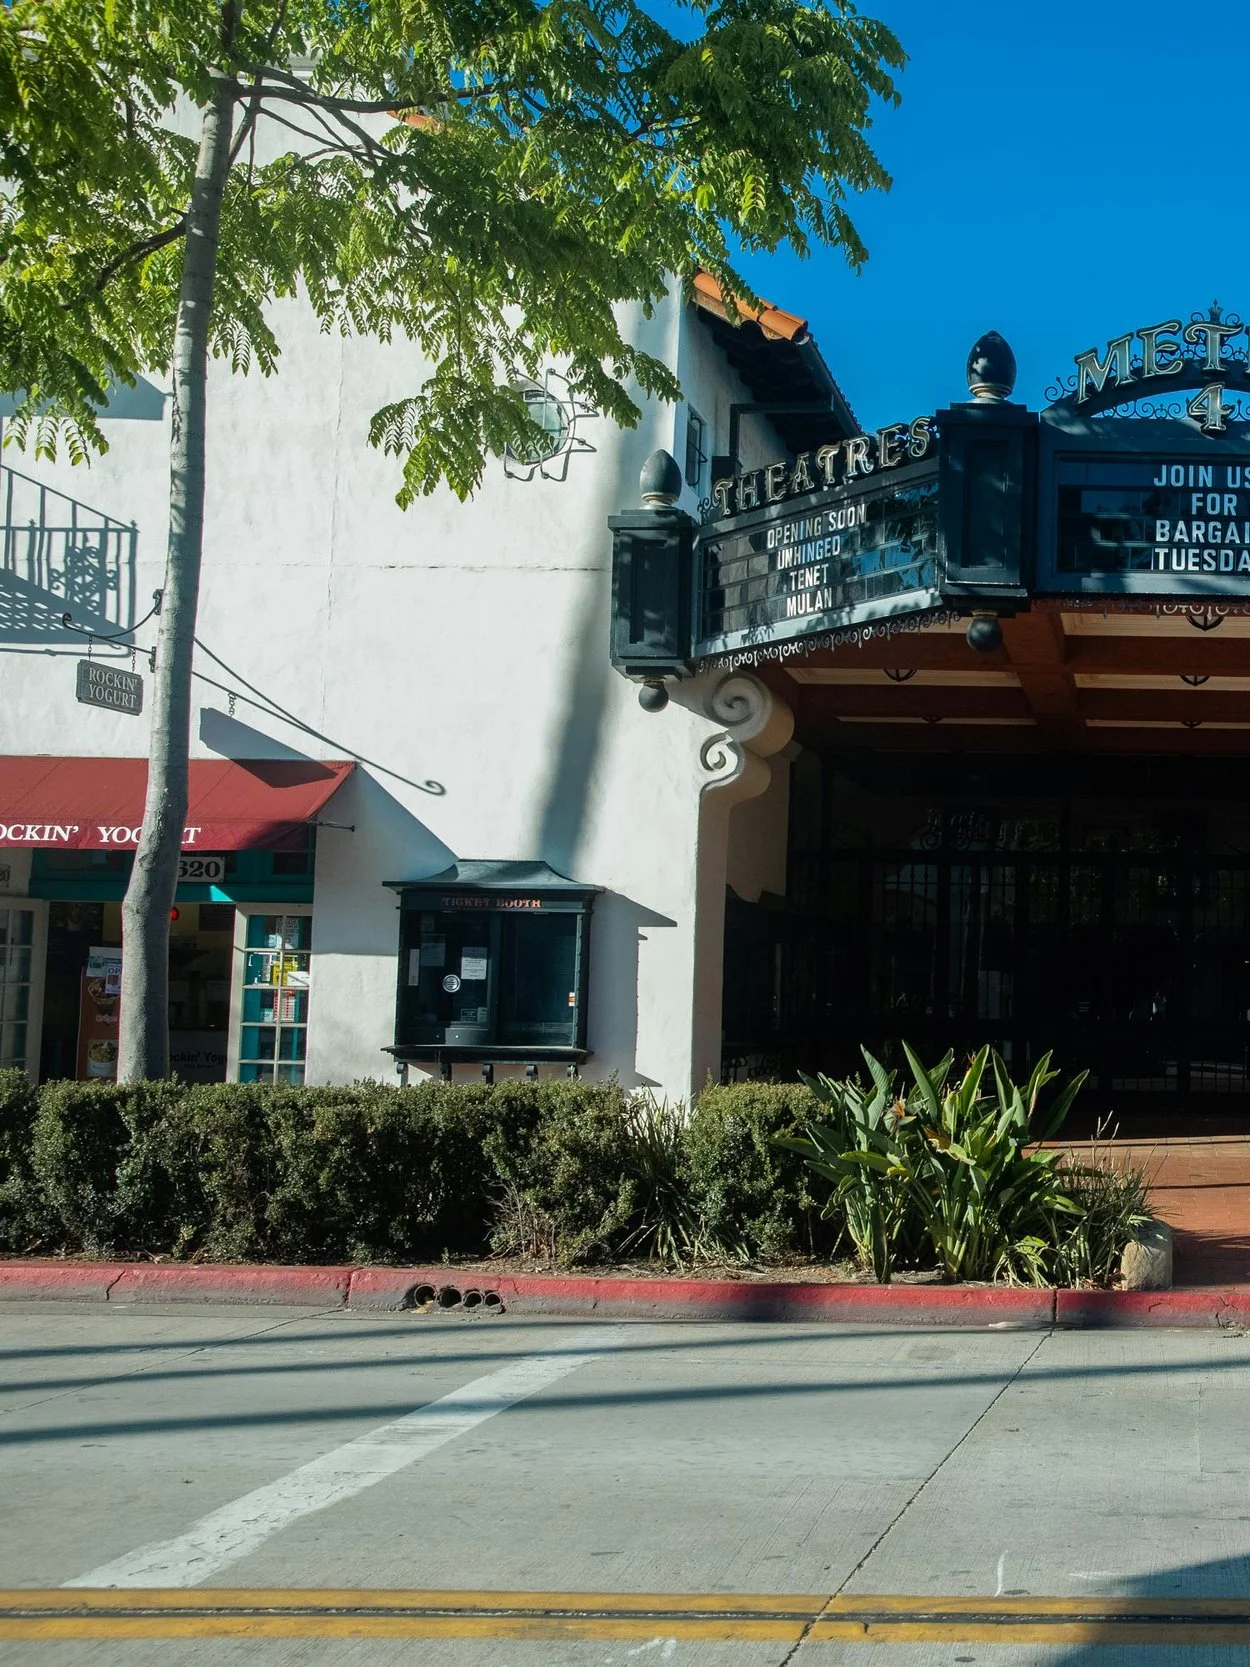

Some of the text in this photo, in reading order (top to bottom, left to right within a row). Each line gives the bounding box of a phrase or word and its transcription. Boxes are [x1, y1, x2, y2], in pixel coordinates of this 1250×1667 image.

[1187, 381, 1235, 432] 4
[712, 416, 933, 516] THEATRES
[1153, 465, 1213, 487] JOIN
[1191, 493, 1237, 516] FOR
[767, 504, 867, 549] OPENING SOON
[777, 535, 841, 570] UNHINGED
[790, 563, 829, 592] TENET
[786, 587, 833, 618] MULAN
[89, 667, 137, 692] ROCKIN'
[89, 683, 137, 708] YOGURT
[442, 897, 541, 908] TICKET BOOTH
[169, 1051, 201, 1062] ockin'
